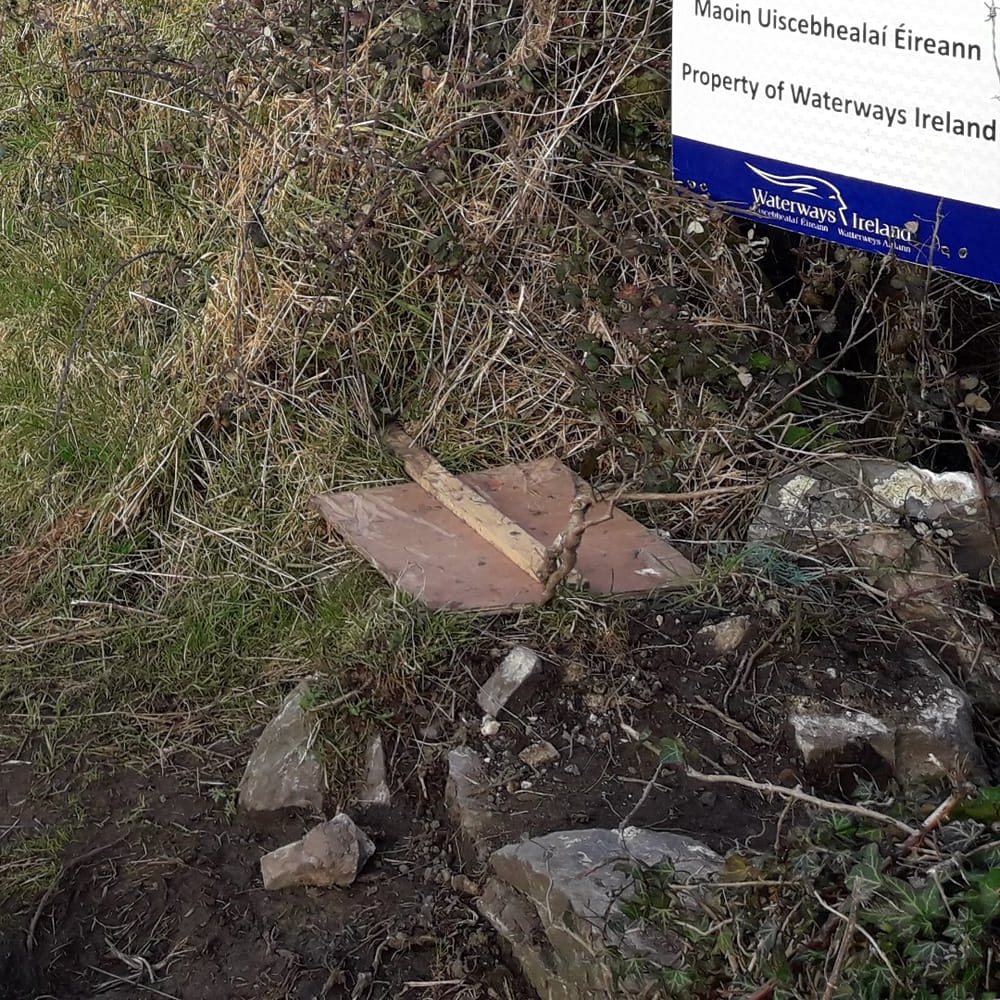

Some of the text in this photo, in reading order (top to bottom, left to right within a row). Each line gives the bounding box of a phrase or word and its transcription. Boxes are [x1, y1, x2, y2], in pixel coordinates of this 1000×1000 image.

[757, 7, 887, 47] Uiscebhealaí
[894, 22, 982, 61] Éireann
[682, 62, 997, 142] Property of Waterways Ireland
[752, 187, 911, 242] Waterways Ireland
[756, 208, 799, 225] iscebhealaí
